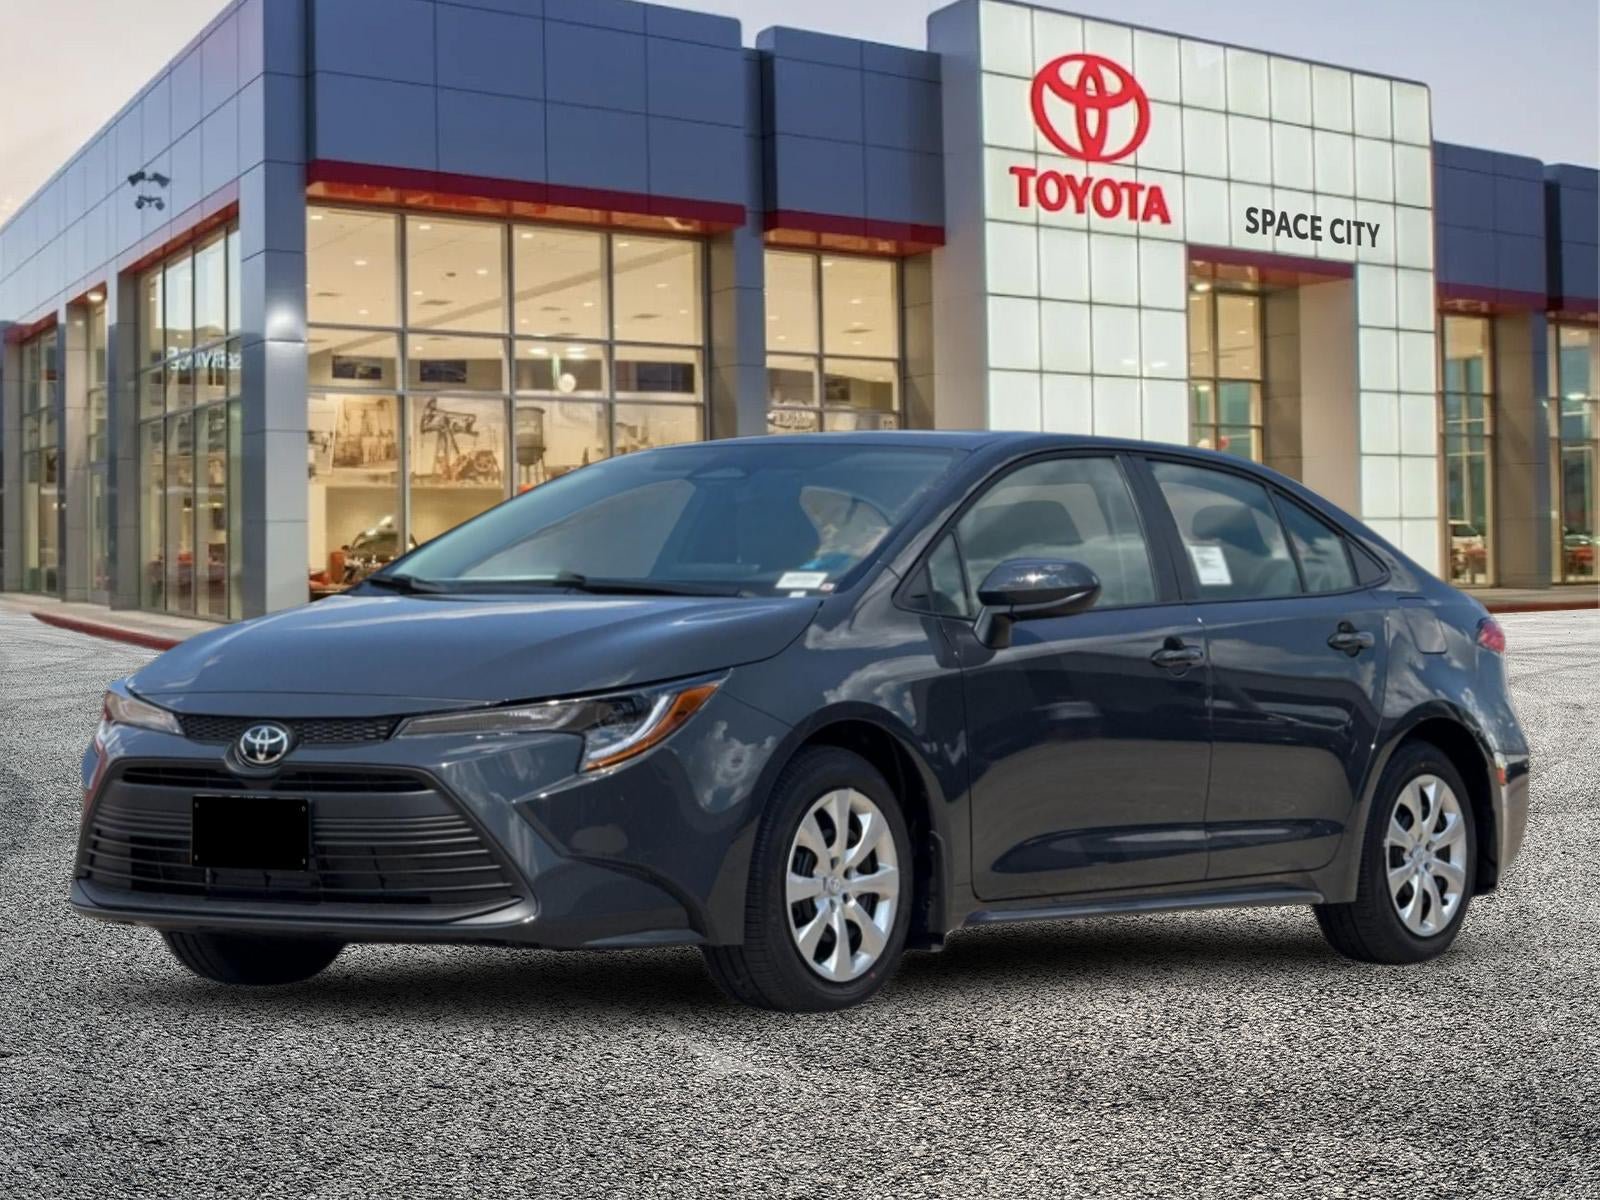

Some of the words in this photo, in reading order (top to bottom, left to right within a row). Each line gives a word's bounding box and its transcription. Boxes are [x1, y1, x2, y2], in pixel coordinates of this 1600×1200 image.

[1009, 166, 1171, 225] TOYOTA
[1245, 206, 1323, 242] SPACE
[1329, 218, 1381, 248] CITY
